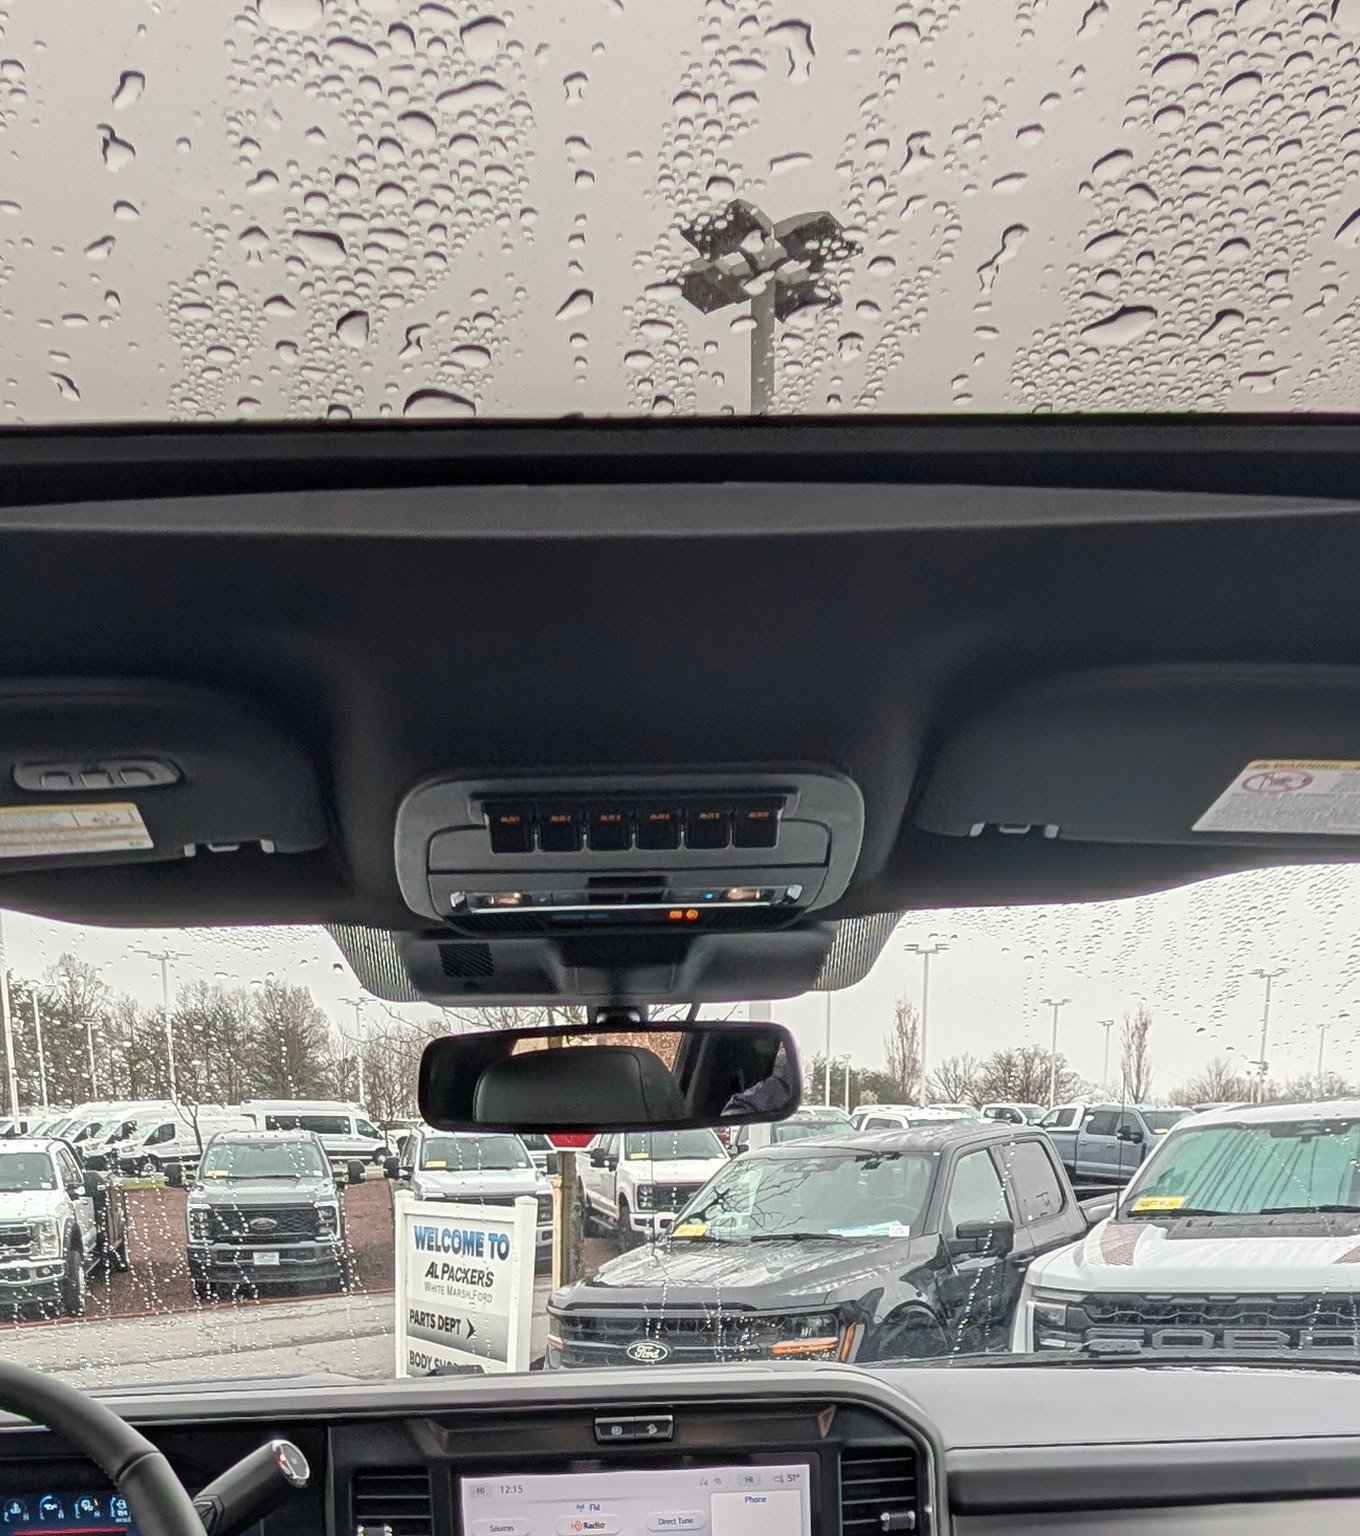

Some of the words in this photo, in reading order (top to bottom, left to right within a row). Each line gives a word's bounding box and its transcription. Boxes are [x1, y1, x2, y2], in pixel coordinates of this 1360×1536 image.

[414, 1226, 485, 1258] WELCOME
[488, 1233, 510, 1261] TO
[425, 1261, 439, 1279] AL
[441, 1263, 495, 1288] PACKER'S
[409, 1309, 435, 1330] PARTS
[437, 1314, 461, 1335] DEPT
[409, 1350, 432, 1371] BODY
[632, 1344, 662, 1359] Ford
[500, 1485, 523, 1494] 12:15
